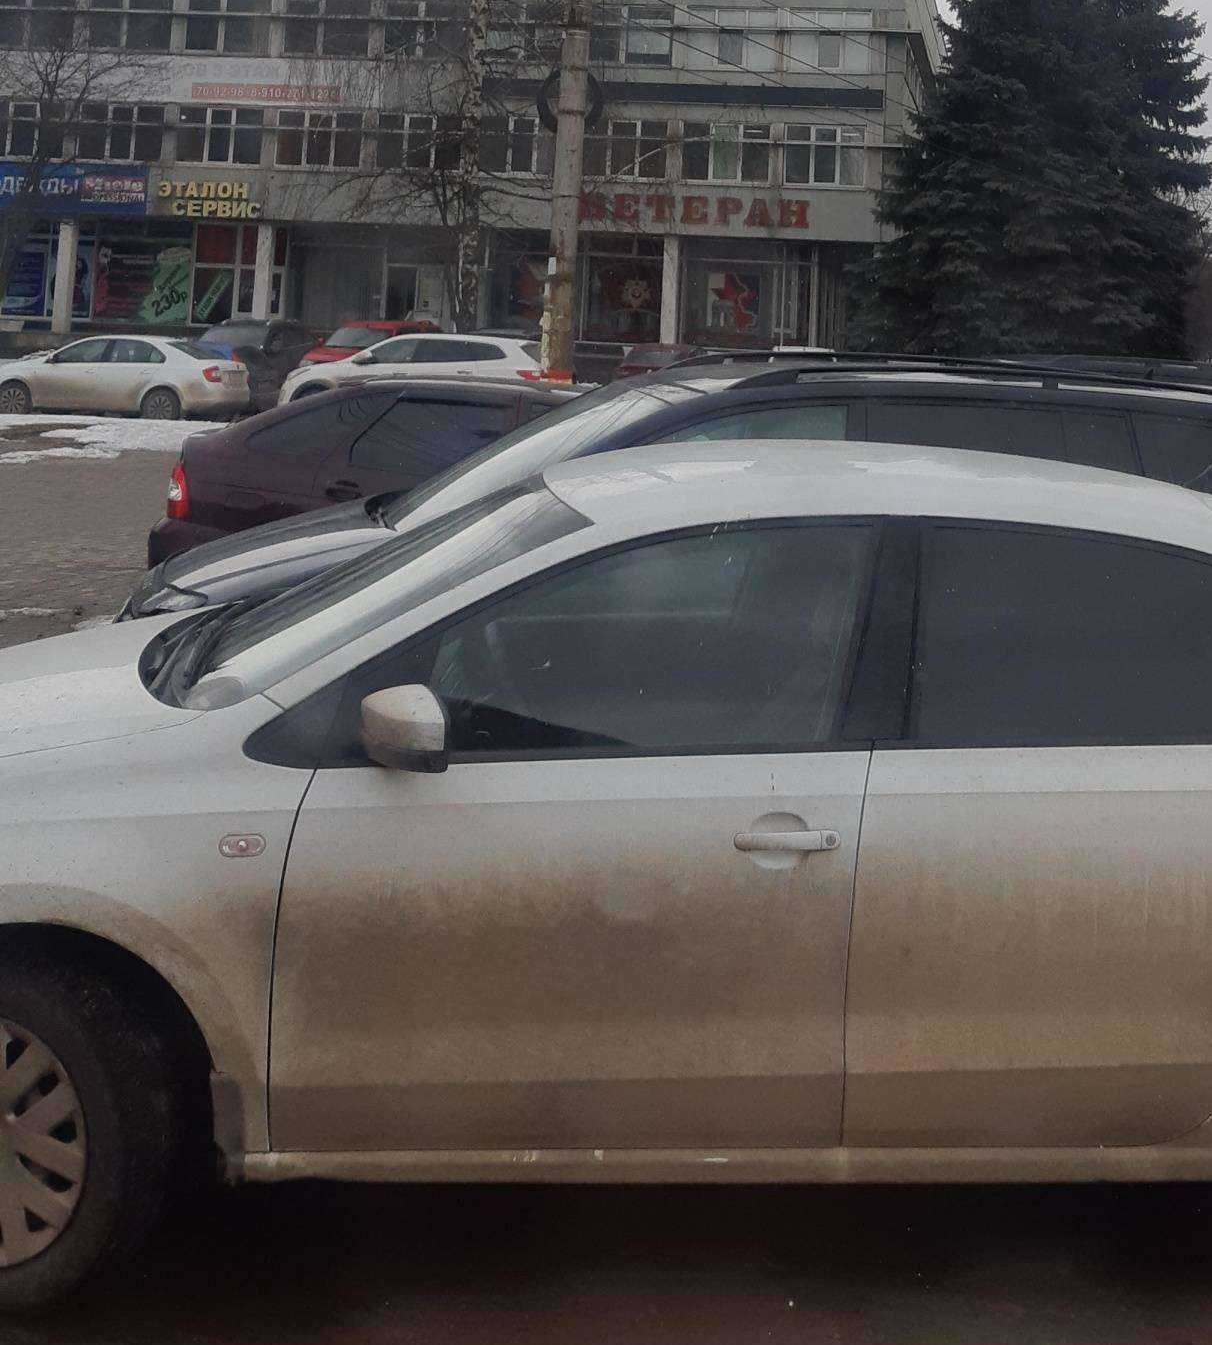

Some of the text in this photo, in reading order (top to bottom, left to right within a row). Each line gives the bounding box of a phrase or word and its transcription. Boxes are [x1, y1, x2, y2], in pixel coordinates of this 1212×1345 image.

[158, 180, 249, 198] ЭТАЛОН
[172, 199, 261, 218] СЕРВИС
[578, 193, 810, 229] ВЕТЕРАН
